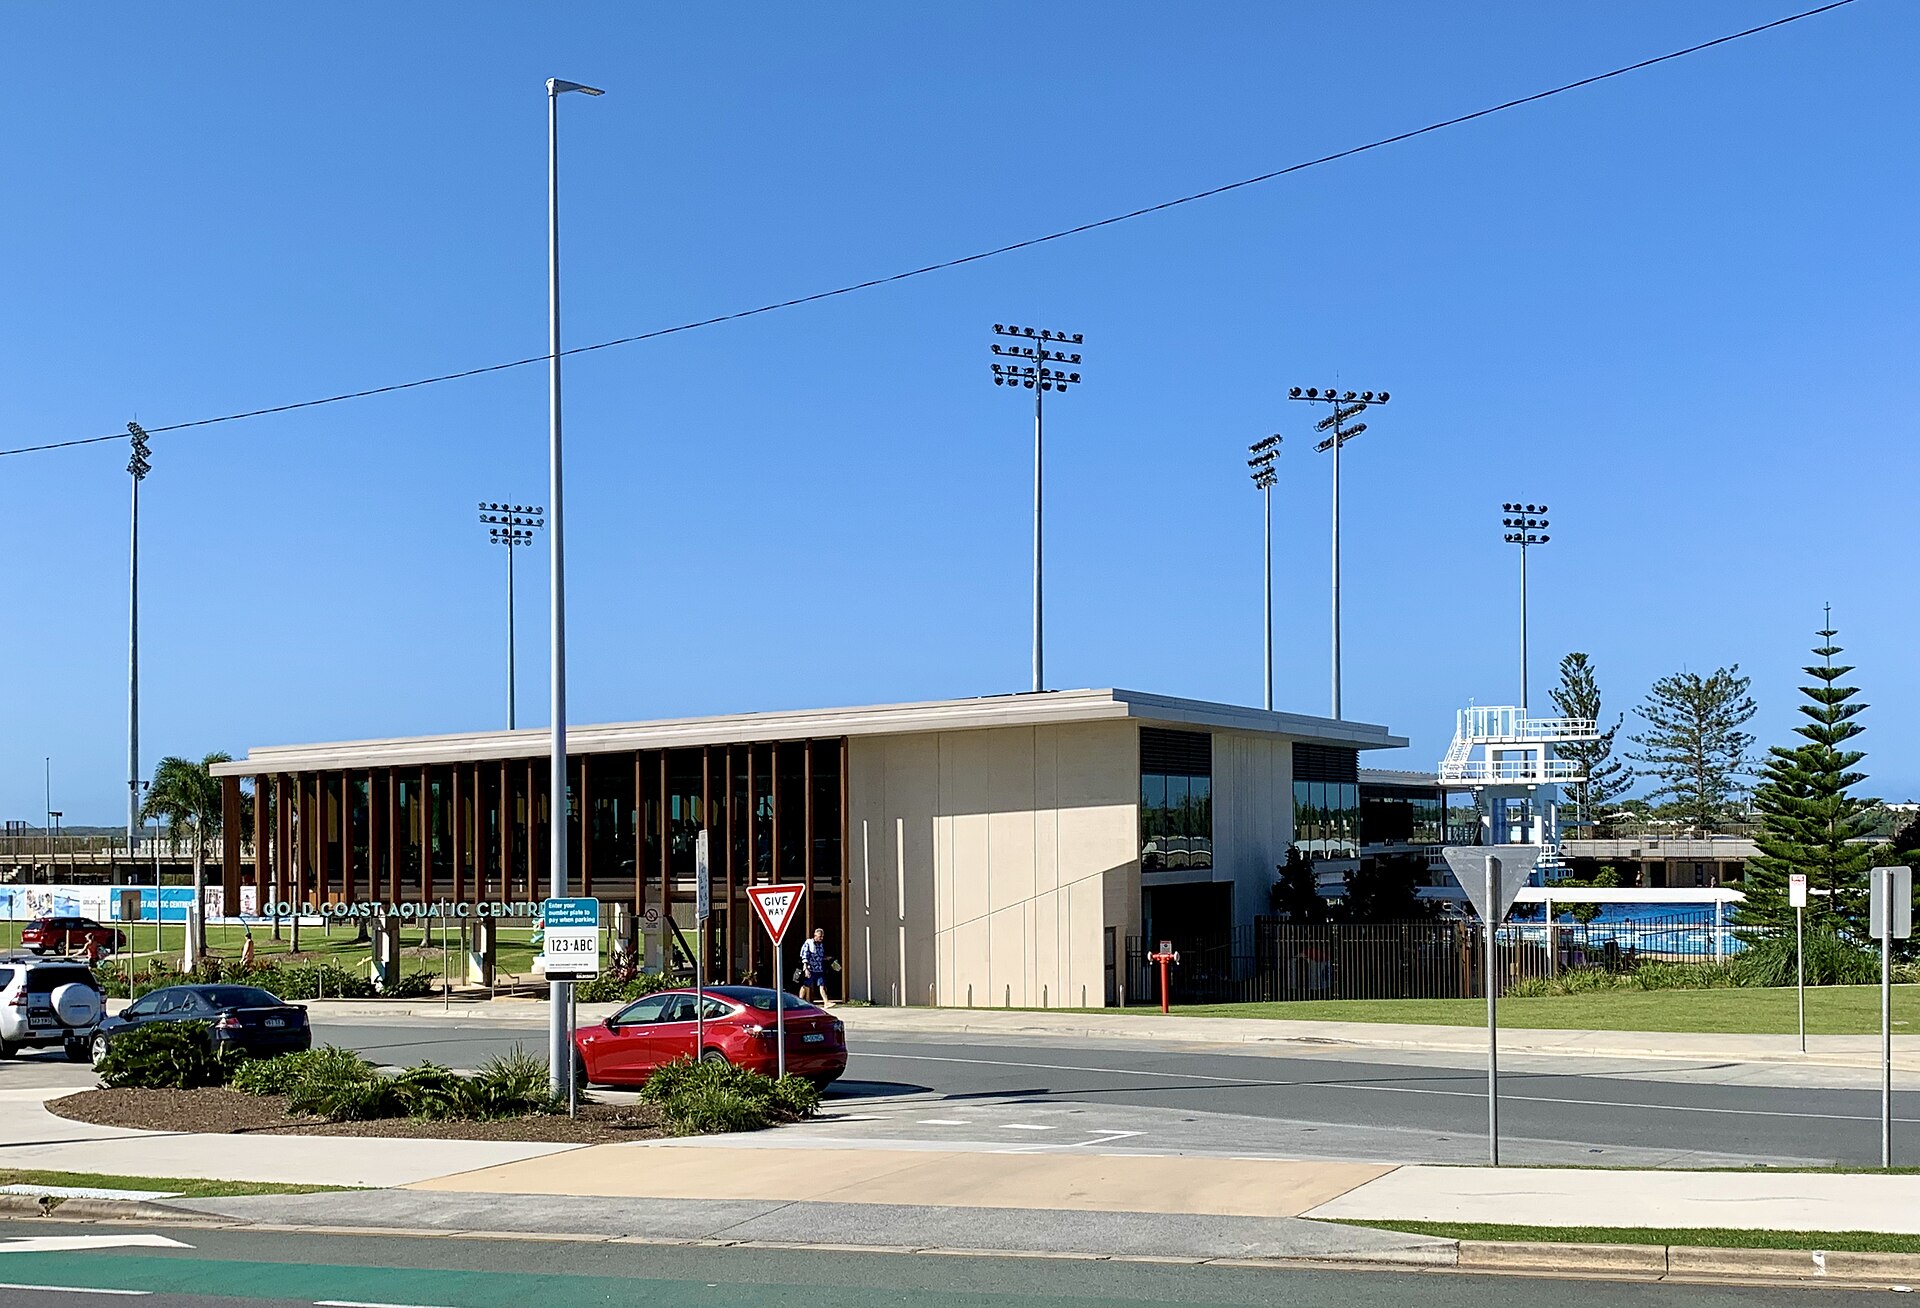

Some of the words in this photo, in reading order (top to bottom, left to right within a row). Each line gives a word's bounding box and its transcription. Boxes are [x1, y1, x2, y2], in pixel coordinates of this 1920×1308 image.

[764, 895, 788, 906] GIVE
[263, 901, 314, 917] GOLD
[320, 902, 382, 917] COAST
[387, 902, 470, 919] AQUATIC
[767, 907, 785, 916] WAY
[574, 916, 596, 924] parking
